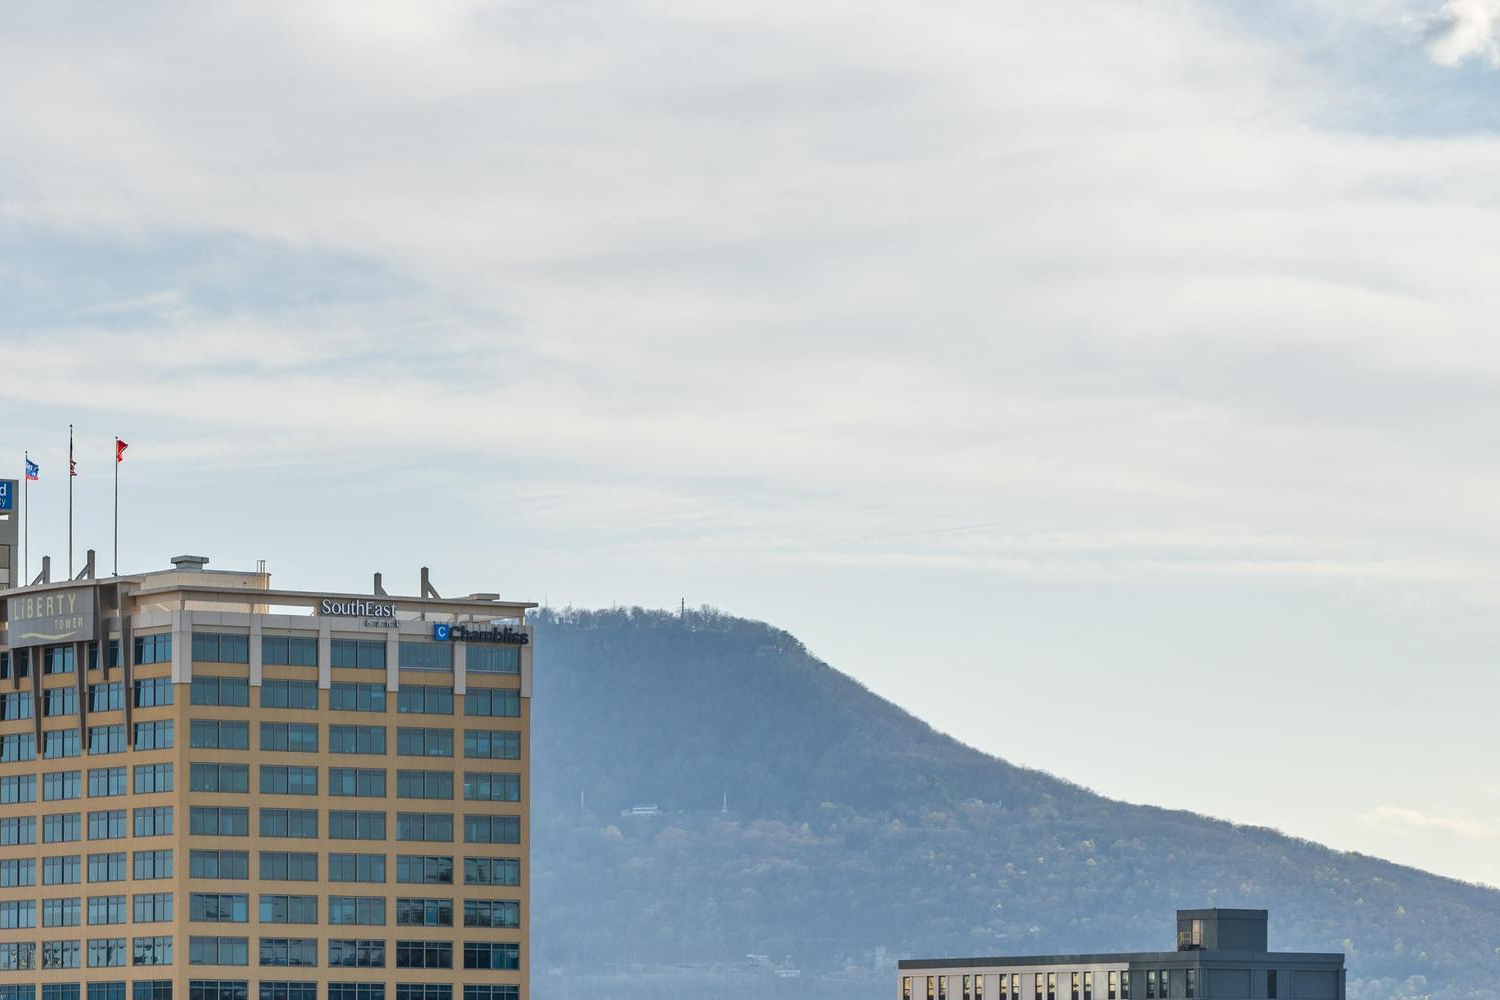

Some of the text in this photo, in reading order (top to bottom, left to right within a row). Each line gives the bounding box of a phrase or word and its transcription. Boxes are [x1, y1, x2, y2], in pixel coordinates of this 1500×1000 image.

[321, 598, 397, 618] SouthEast
[54, 618, 83, 631] TOWER
[450, 624, 530, 645] Chambliss
